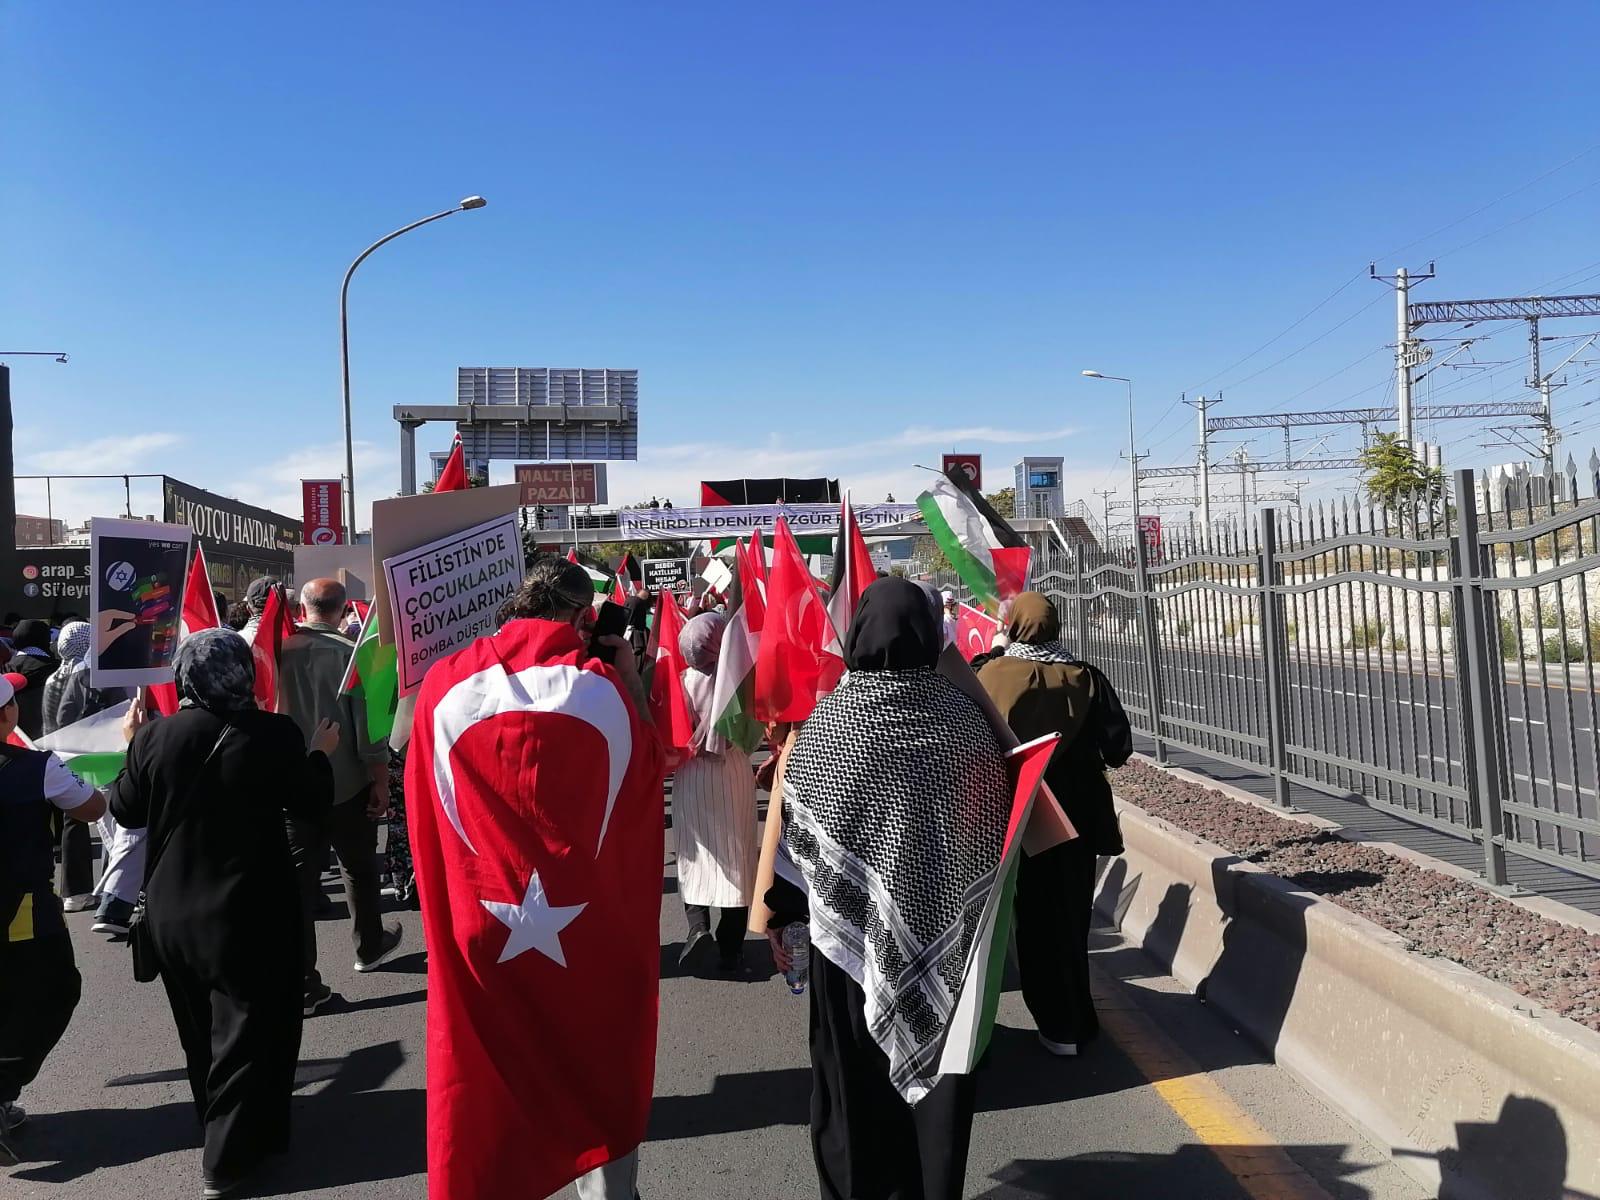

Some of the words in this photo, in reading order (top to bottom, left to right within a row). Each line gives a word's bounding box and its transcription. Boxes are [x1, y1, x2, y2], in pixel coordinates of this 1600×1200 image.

[519, 469, 593, 482] MALTEPE
[527, 486, 586, 500] PAZARI
[232, 513, 277, 551] HAYDAR
[628, 516, 710, 530] NEHİRDEN
[714, 513, 773, 527] DENİZE
[1140, 518, 1160, 532] 50
[409, 533, 507, 588] FİLİSTİN'DE
[405, 554, 516, 621] ÇOCUKLARIN
[655, 575, 677, 584] HESAP
[411, 580, 516, 642] RÜYALARINA
[411, 637, 455, 666] BOMBA
[456, 614, 493, 643] DÜŞTÜ
